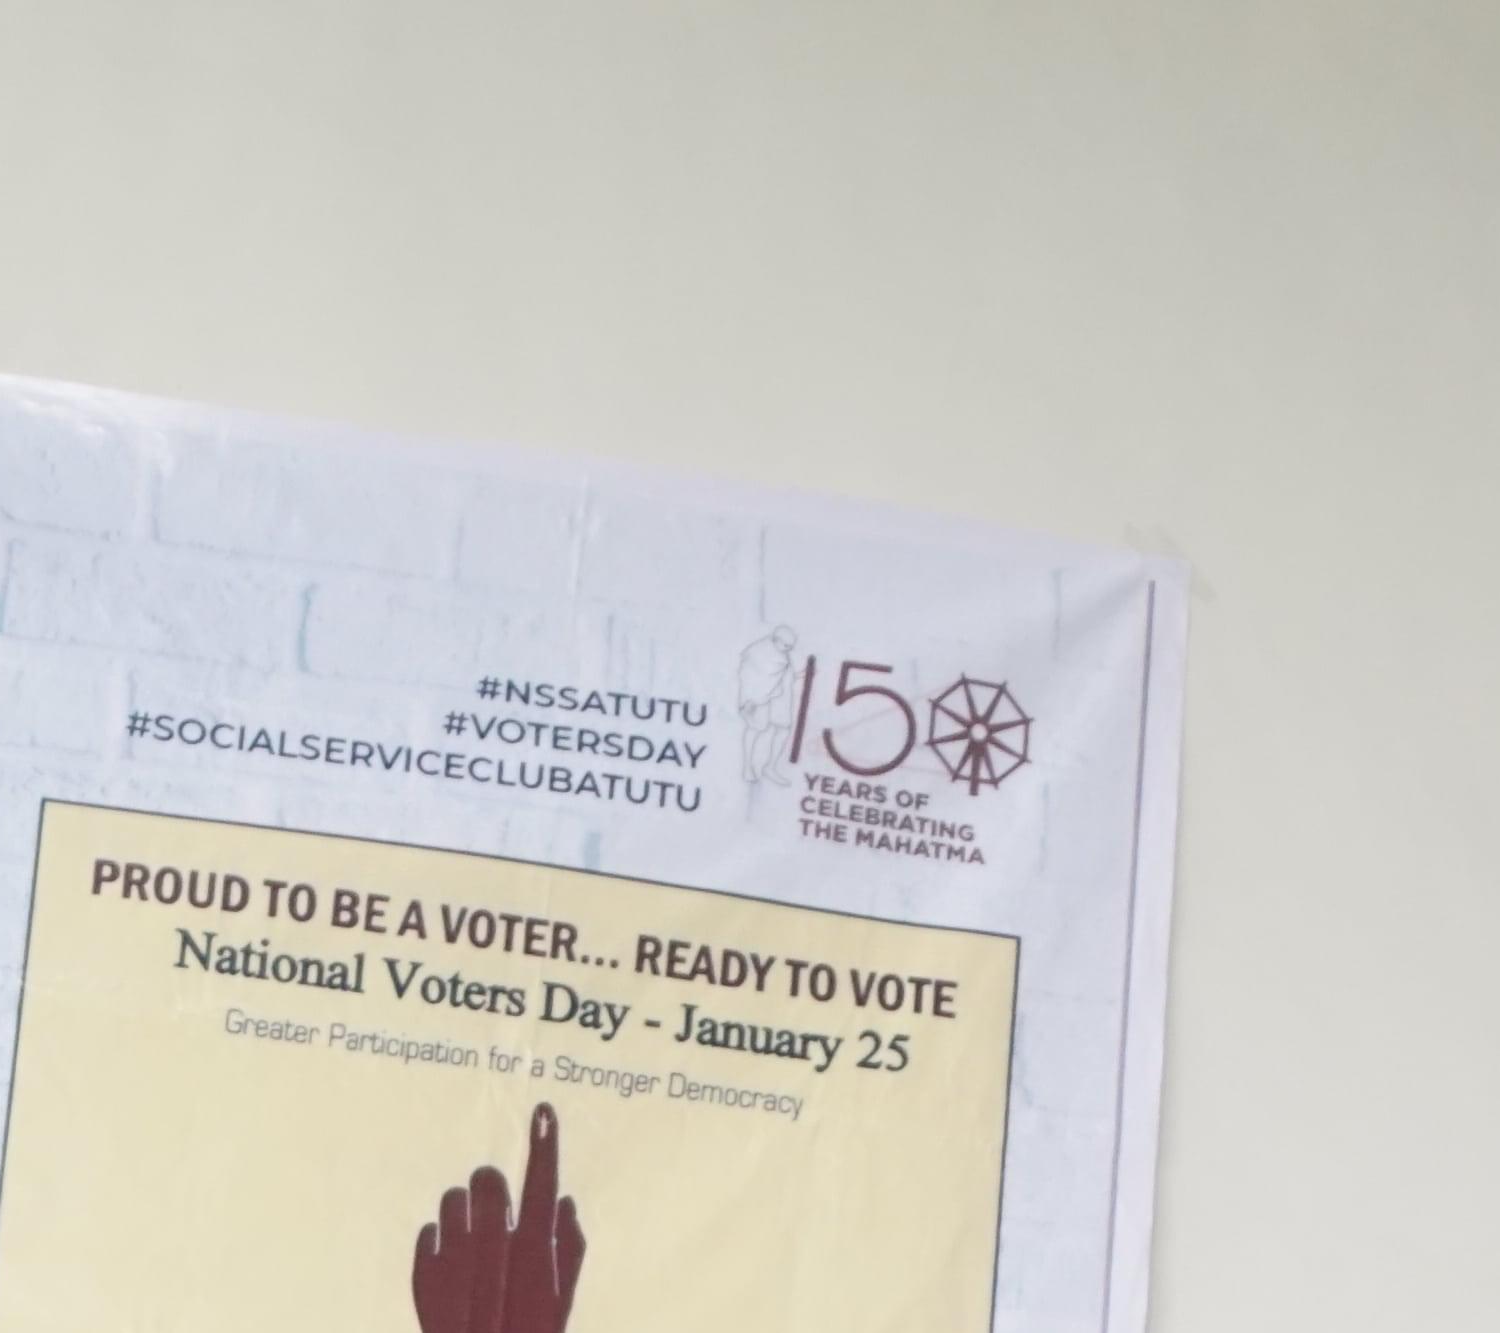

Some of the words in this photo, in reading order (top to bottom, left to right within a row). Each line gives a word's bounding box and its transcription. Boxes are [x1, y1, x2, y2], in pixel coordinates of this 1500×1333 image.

[476, 675, 709, 727] #NSSATUTU
[125, 709, 702, 814] #SOCIALSERVICECLUBATUTU
[443, 709, 708, 772] #VOTERSDAY
[800, 796, 976, 843] CELEBRATING
[803, 773, 886, 807] YEARS
[894, 787, 930, 812] OF
[800, 819, 846, 844] THE
[853, 825, 987, 866] MAHATMA
[91, 858, 252, 916] PROUD
[262, 878, 319, 923] TO
[331, 889, 390, 934] BE
[398, 895, 429, 938] A
[441, 903, 620, 969] VOTER...
[634, 934, 775, 994] READY
[783, 956, 839, 1003] TO
[849, 968, 958, 1018] VOTE
[173, 928, 365, 996] National
[385, 957, 527, 1017] Voters
[542, 981, 630, 1040] Day
[674, 1003, 842, 1071] January
[855, 1028, 911, 1074] 25
[225, 1008, 319, 1046] Greater
[326, 1020, 480, 1074] Participation
[484, 1042, 523, 1073] for
[530, 1058, 546, 1078] a
[554, 1054, 661, 1098] Stronger
[668, 1072, 804, 1120] Democracy
